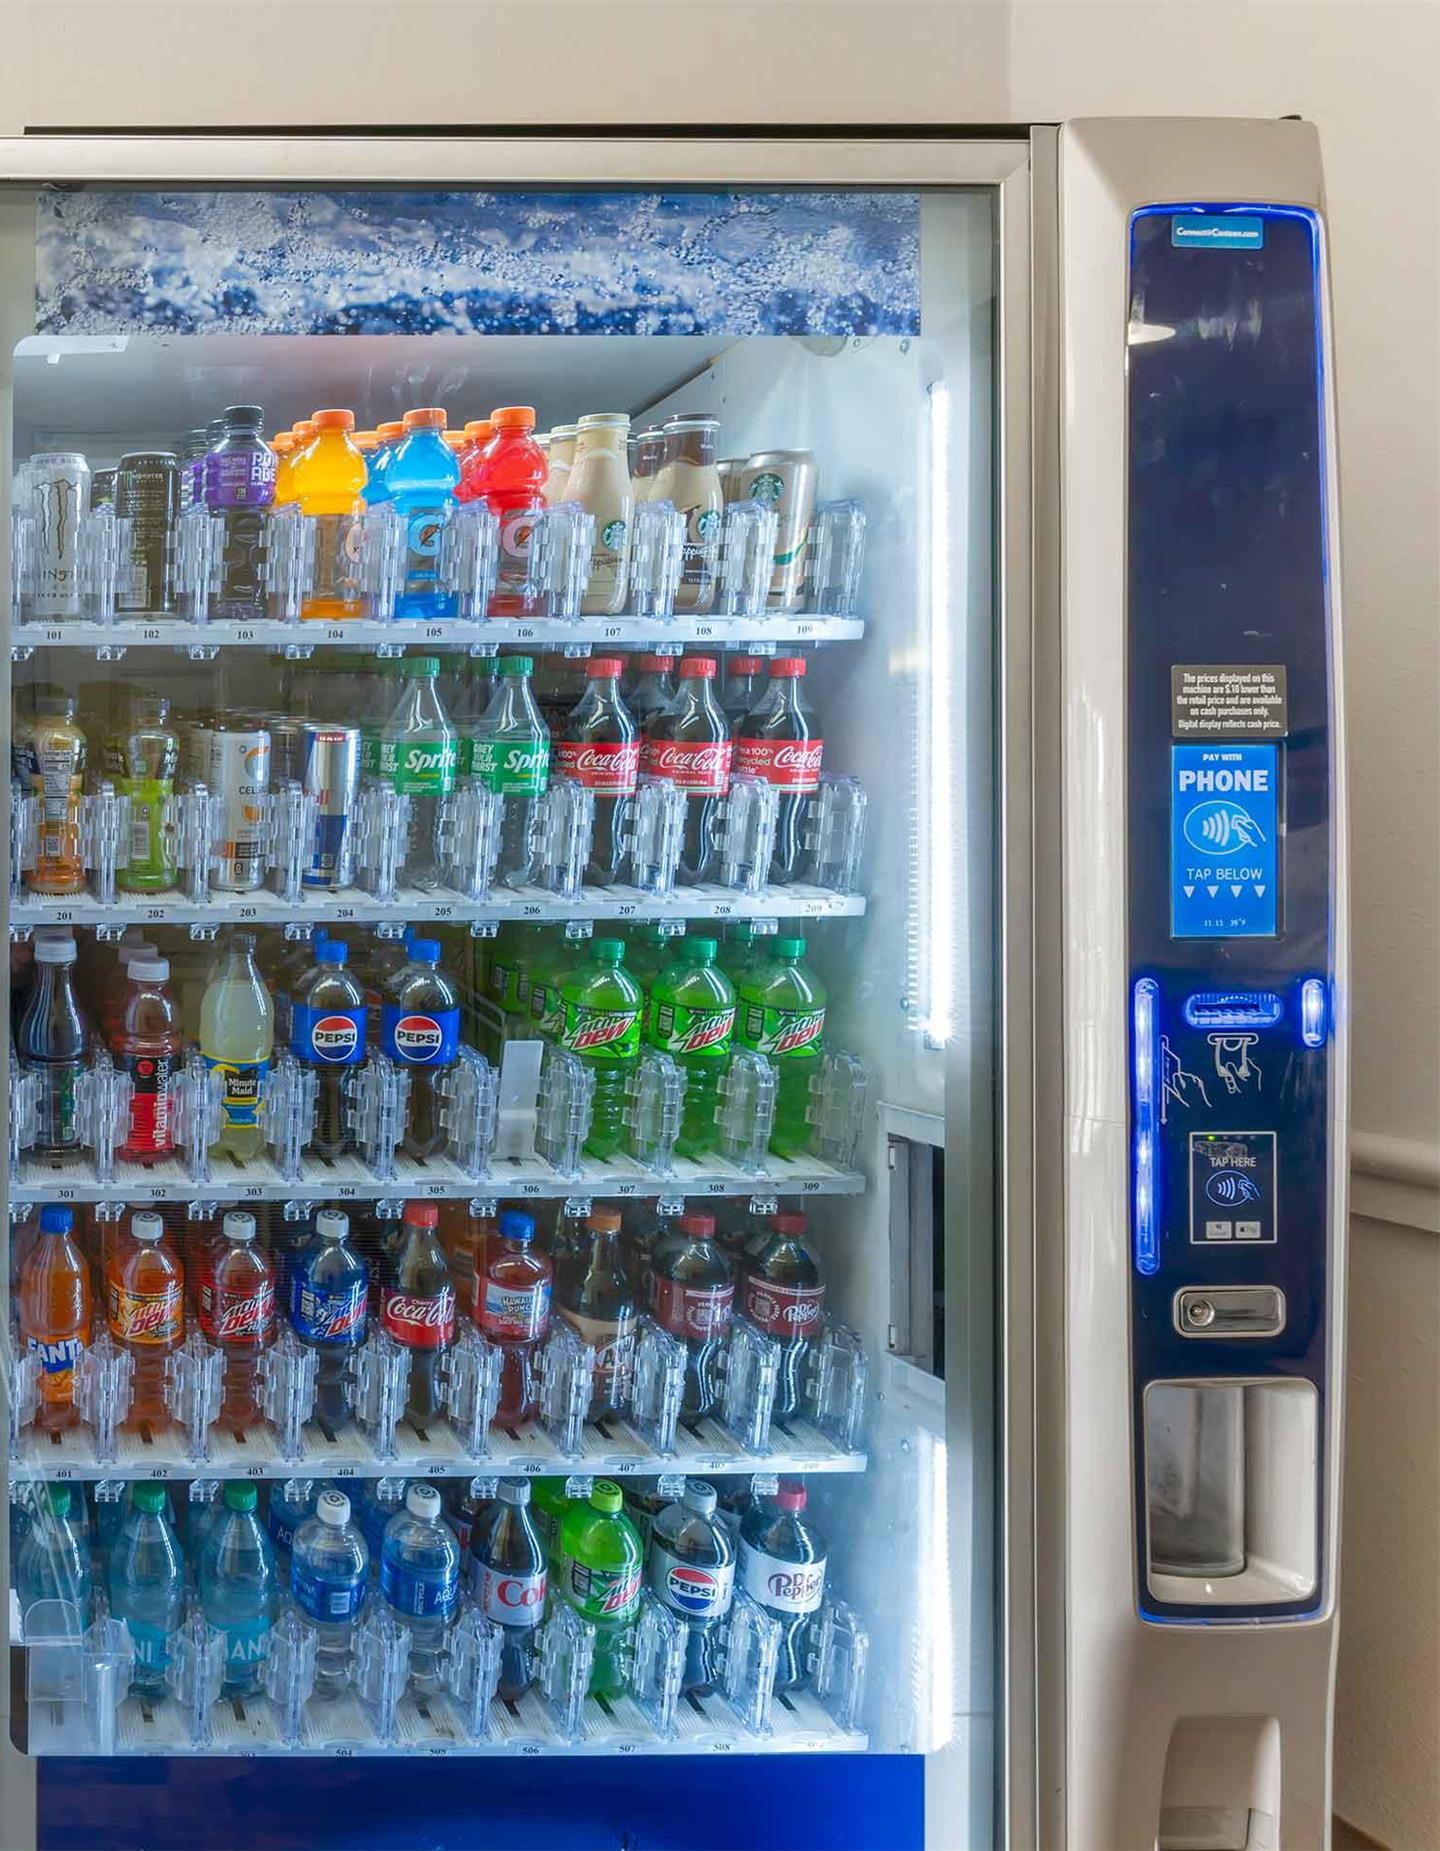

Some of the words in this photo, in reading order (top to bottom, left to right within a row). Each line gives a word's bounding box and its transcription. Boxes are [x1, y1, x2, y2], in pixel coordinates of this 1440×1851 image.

[143, 630, 160, 639] 102
[327, 630, 344, 640] 104
[517, 628, 534, 638] 106
[696, 626, 712, 636] 108
[1183, 673, 1196, 683] The
[1197, 673, 1218, 686] prices
[1219, 673, 1251, 684] displayed
[1252, 675, 1261, 683] on
[1261, 673, 1275, 683] this
[1183, 685, 1211, 694] machine
[1212, 686, 1224, 694] are
[1225, 684, 1240, 694] $.10
[1240, 685, 1259, 694] lower
[1260, 685, 1276, 694] than
[1176, 695, 1188, 705] the
[1189, 695, 1206, 705] retail
[1207, 695, 1225, 707] price
[1225, 695, 1239, 705] and
[1239, 697, 1251, 705] are
[1252, 695, 1282, 705] available
[1190, 708, 1199, 716] on
[1200, 706, 1217, 716] cash
[1217, 706, 1252, 718] purchases
[1253, 706, 1269, 718] only.
[1178, 719, 1198, 730] Digital
[1199, 719, 1221, 731] display
[1222, 719, 1246, 729] reflects
[1247, 720, 1262, 729] cash
[1263, 719, 1281, 731] price.
[1202, 753, 1220, 762] PAY
[1221, 753, 1242, 762] WITH
[1178, 769, 1268, 793] PHONE
[1187, 868, 1211, 880] TAP
[1217, 868, 1263, 881] BELOW
[147, 909, 164, 919] 202
[337, 908, 354, 918] 204
[435, 907, 452, 917] 205
[618, 905, 636, 915] 207
[315, 1032, 355, 1043] PEPSI
[397, 1030, 439, 1044] PEPSI
[228, 1078, 257, 1088] Minute
[231, 1086, 253, 1096] Maid
[153, 1058, 169, 1148] vitaminwater
[1210, 1157, 1229, 1167] TAP
[1231, 1157, 1257, 1167] HERE
[338, 1187, 355, 1197] 304
[618, 1184, 635, 1194] 307
[246, 1467, 264, 1477] 403
[427, 1466, 445, 1475] 405
[617, 1464, 635, 1474] 407
[670, 1576, 716, 1597] PEPSI
